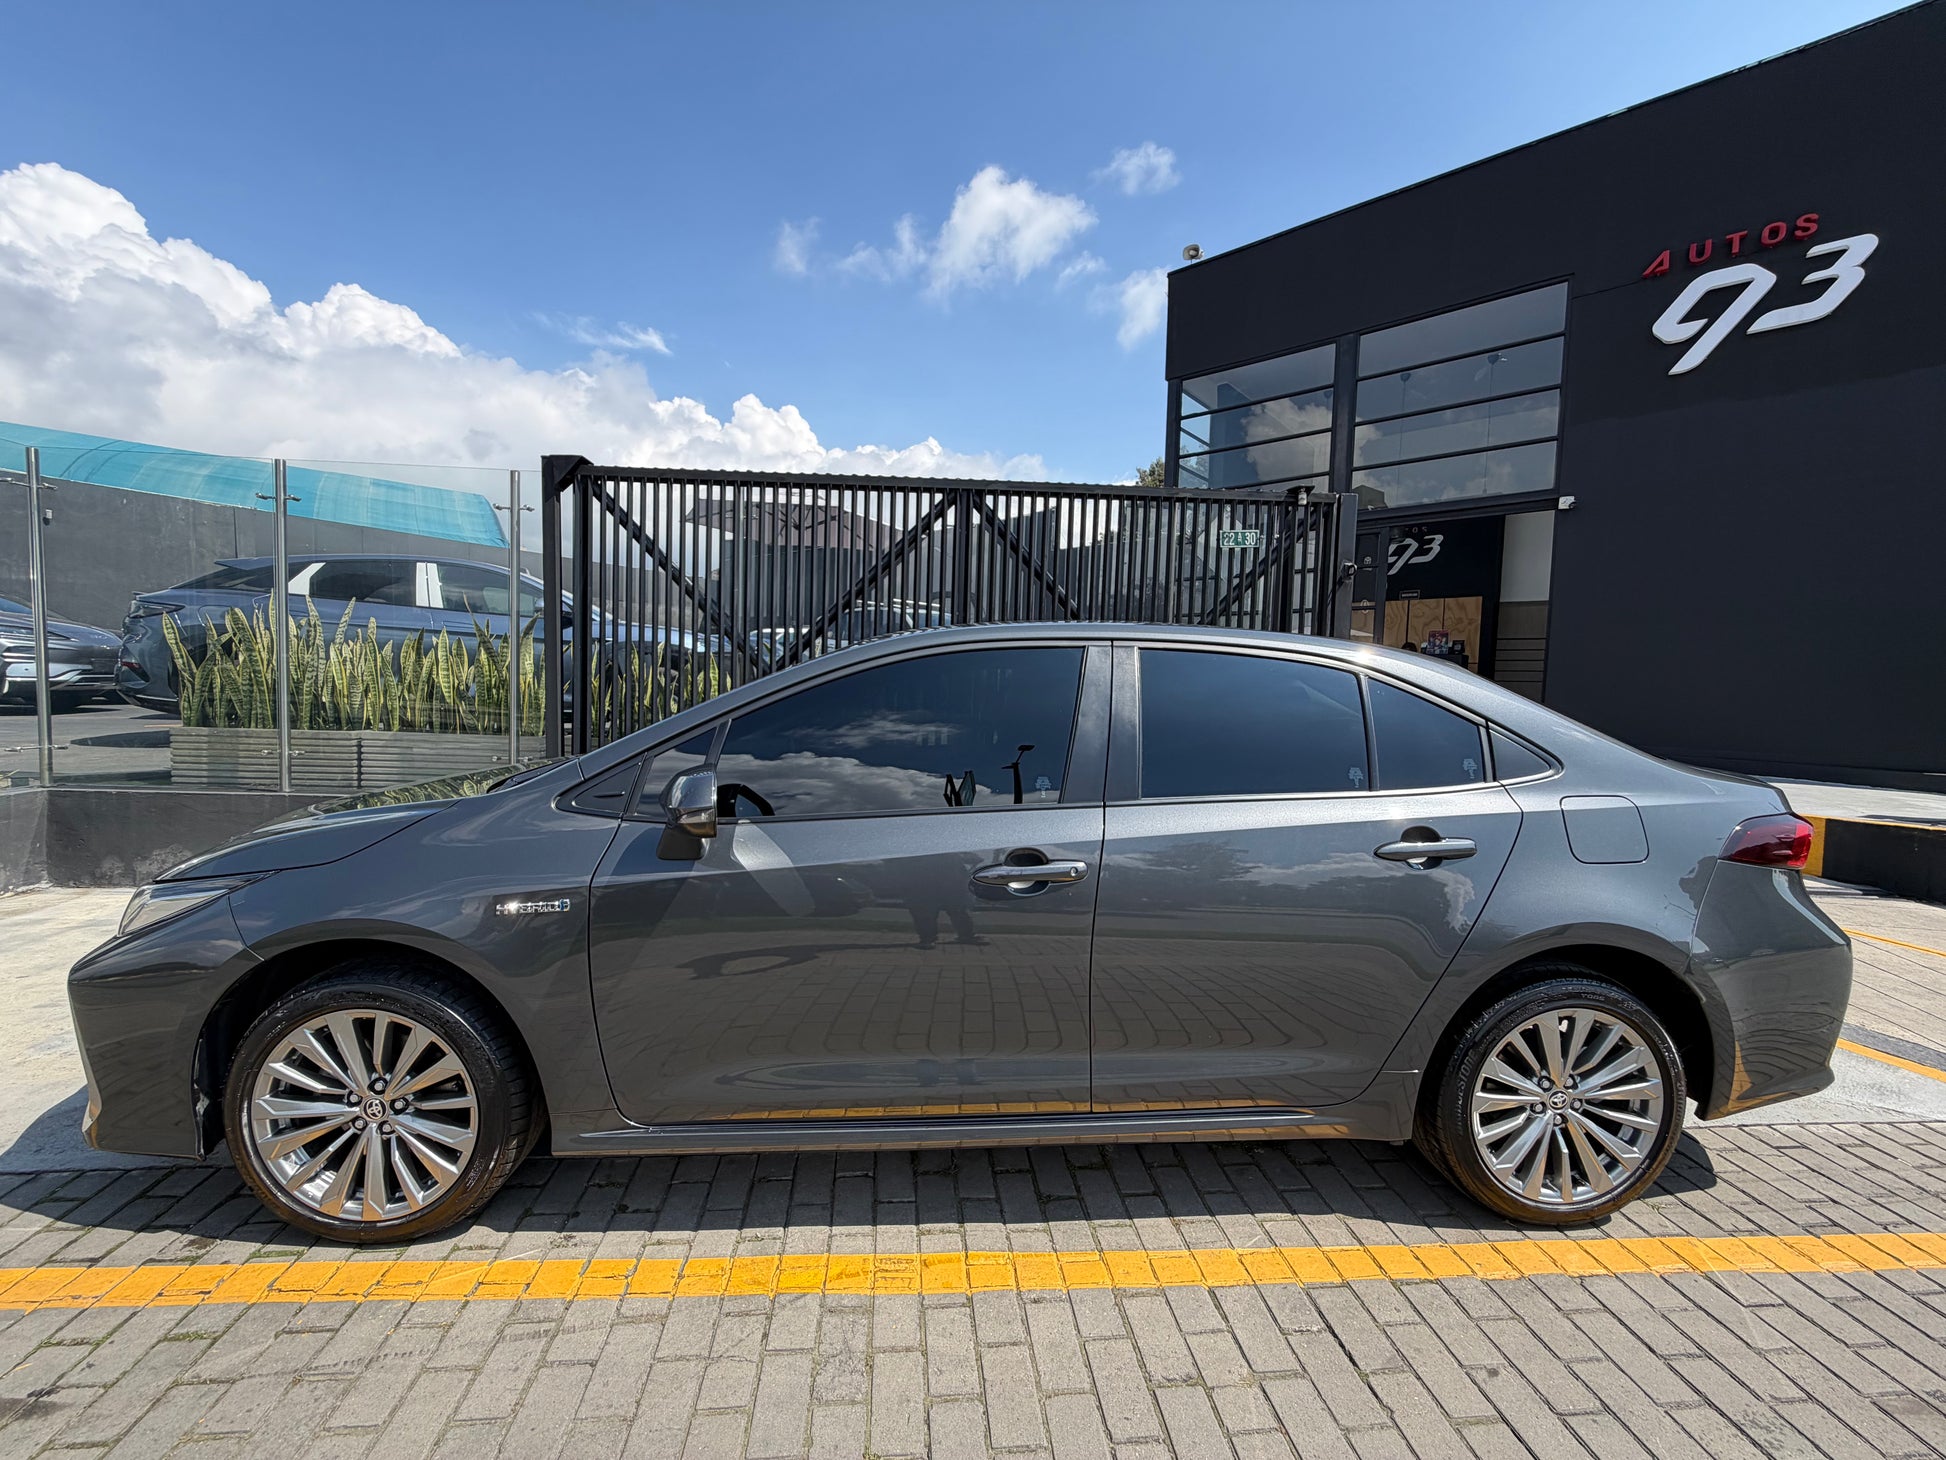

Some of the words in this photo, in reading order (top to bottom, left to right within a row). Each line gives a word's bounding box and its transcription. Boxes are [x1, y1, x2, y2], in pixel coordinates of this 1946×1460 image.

[1642, 213, 1819, 279] AUTOS
[1652, 233, 1879, 376] 93
[1223, 532, 1235, 546] 22
[1245, 532, 1256, 546] 30
[1387, 534, 1444, 576] 93
